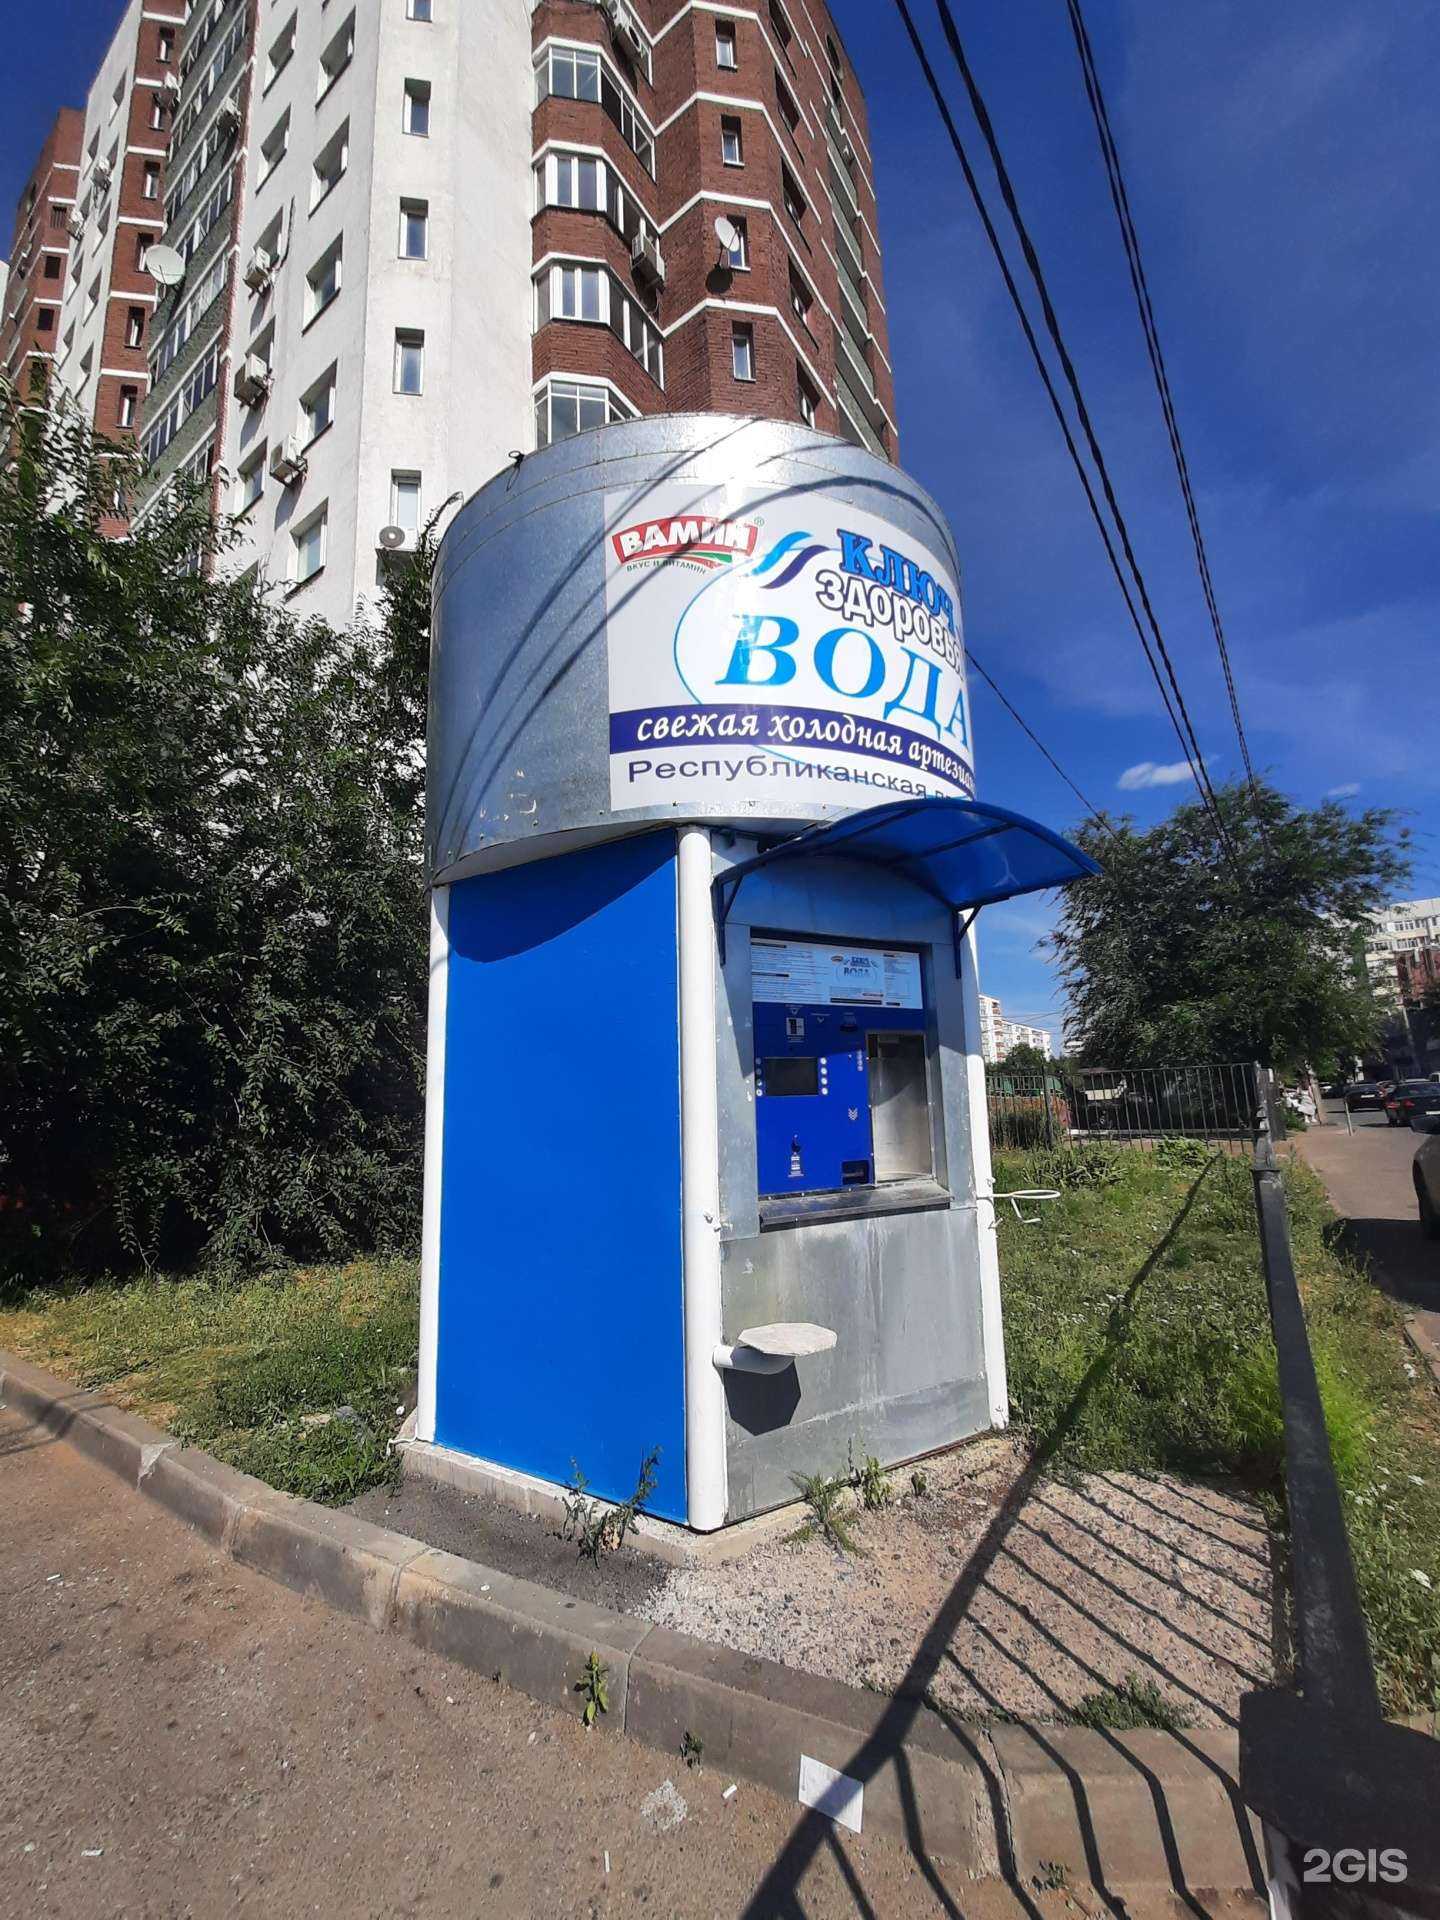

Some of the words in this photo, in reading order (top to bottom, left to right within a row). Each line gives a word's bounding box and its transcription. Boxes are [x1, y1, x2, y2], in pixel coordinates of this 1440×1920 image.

[619, 519, 749, 557] ВАМИН
[626, 561, 650, 573] ВКУС
[714, 613, 969, 752] ВОДА
[637, 713, 759, 741] свежая
[767, 714, 902, 755] холодная
[908, 741, 976, 791] артезиа
[628, 755, 927, 800] Республиканская
